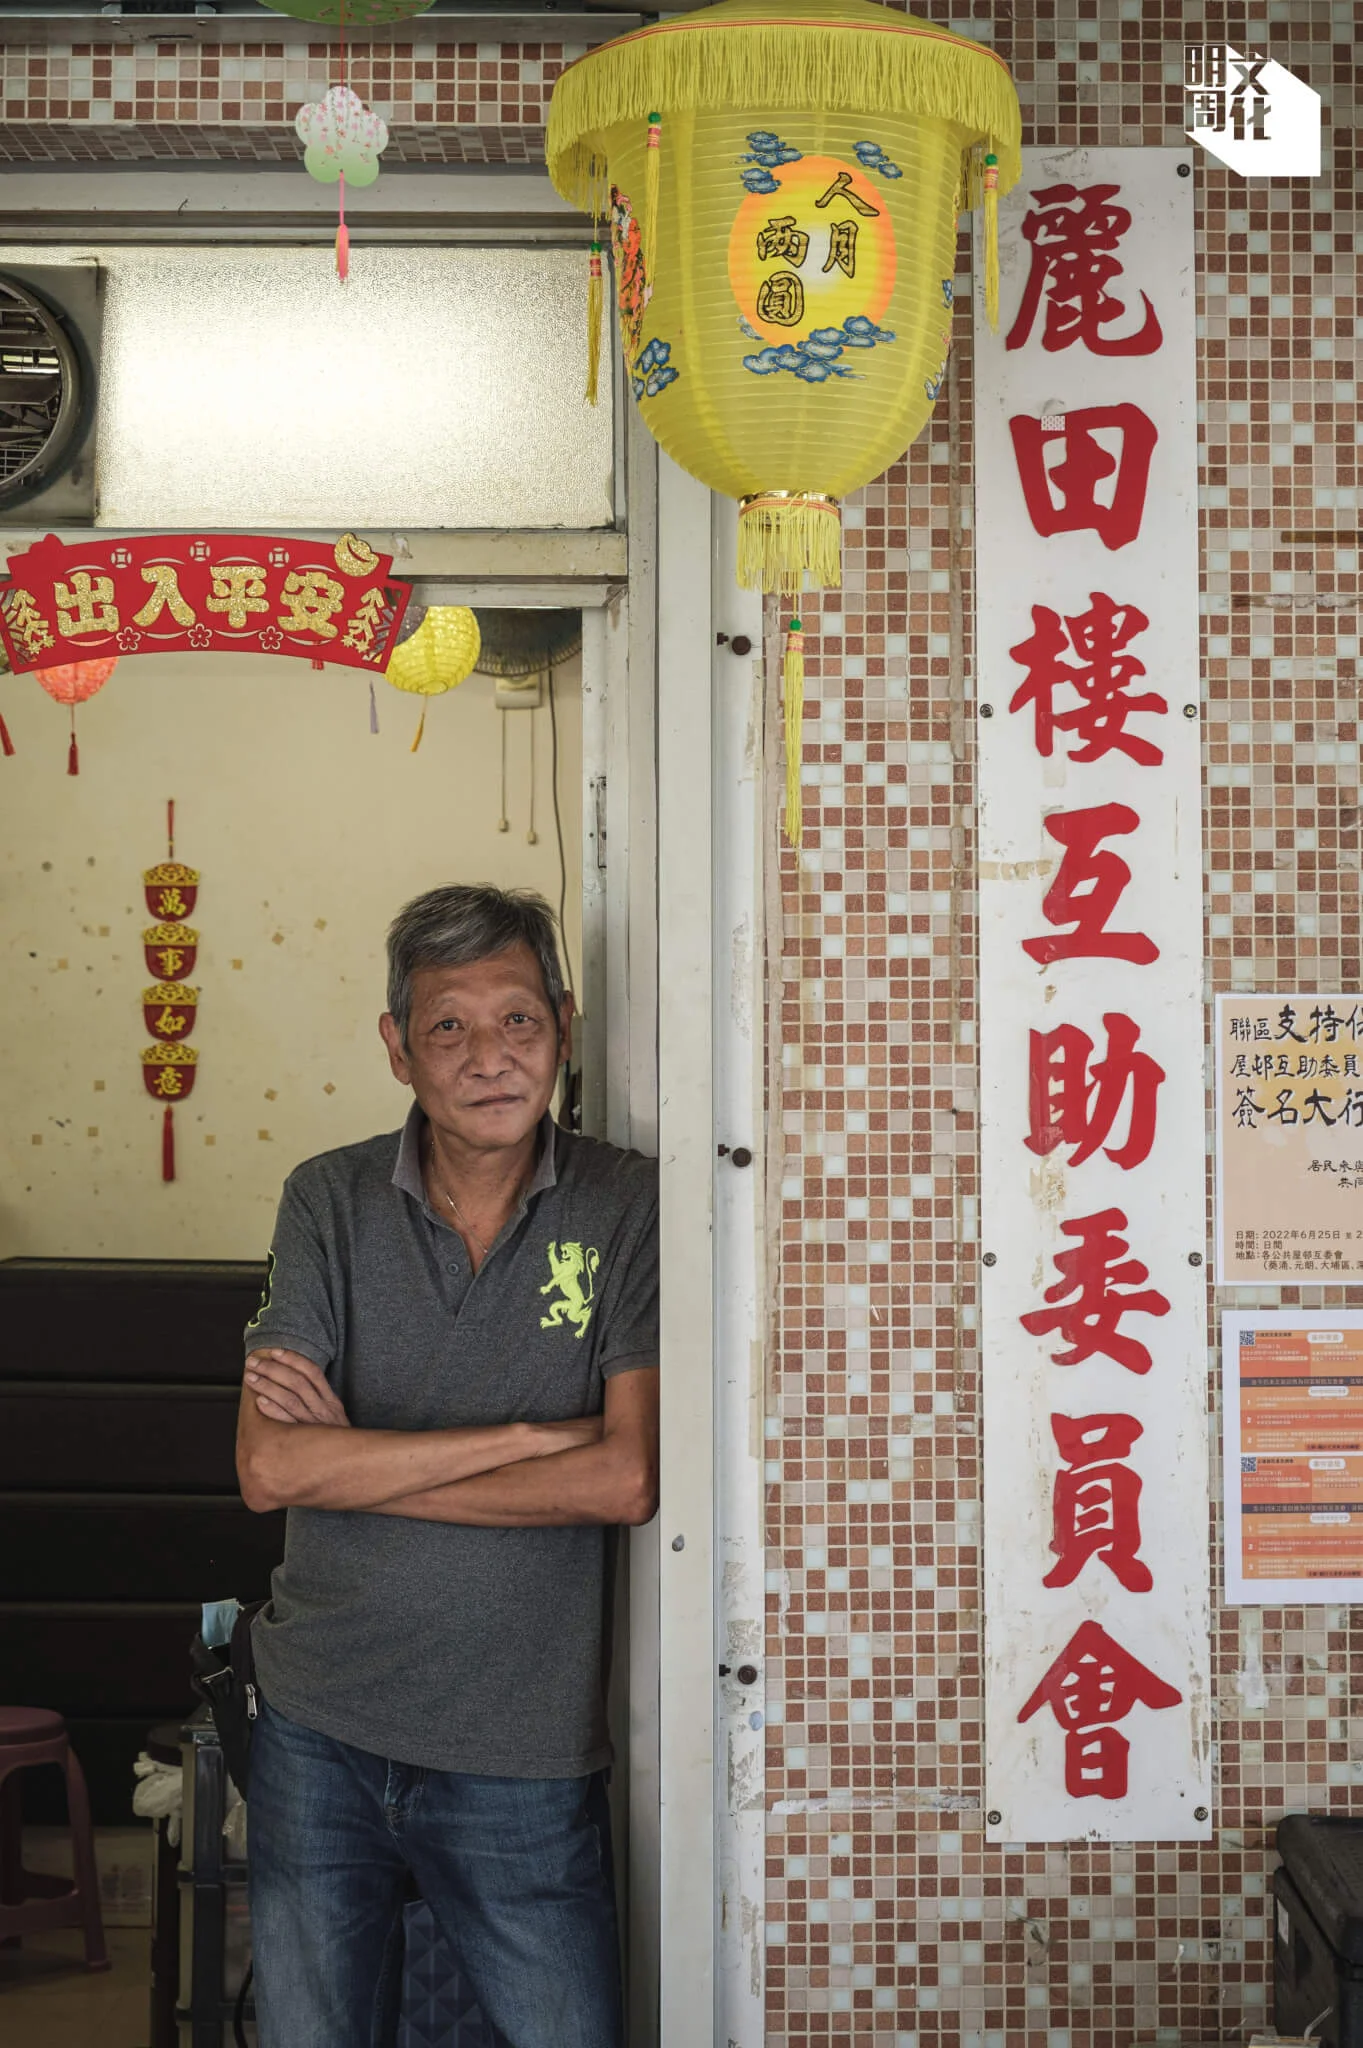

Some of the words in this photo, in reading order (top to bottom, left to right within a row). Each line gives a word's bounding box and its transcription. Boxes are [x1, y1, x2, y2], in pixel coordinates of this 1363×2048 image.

[756, 215, 810, 327] 兩圓
[815, 171, 880, 279] 人月
[53, 565, 344, 638] 出入平安
[154, 888, 187, 1096] 萬事如意
[1005, 183, 1182, 1800] 麗田樓互助委員會
